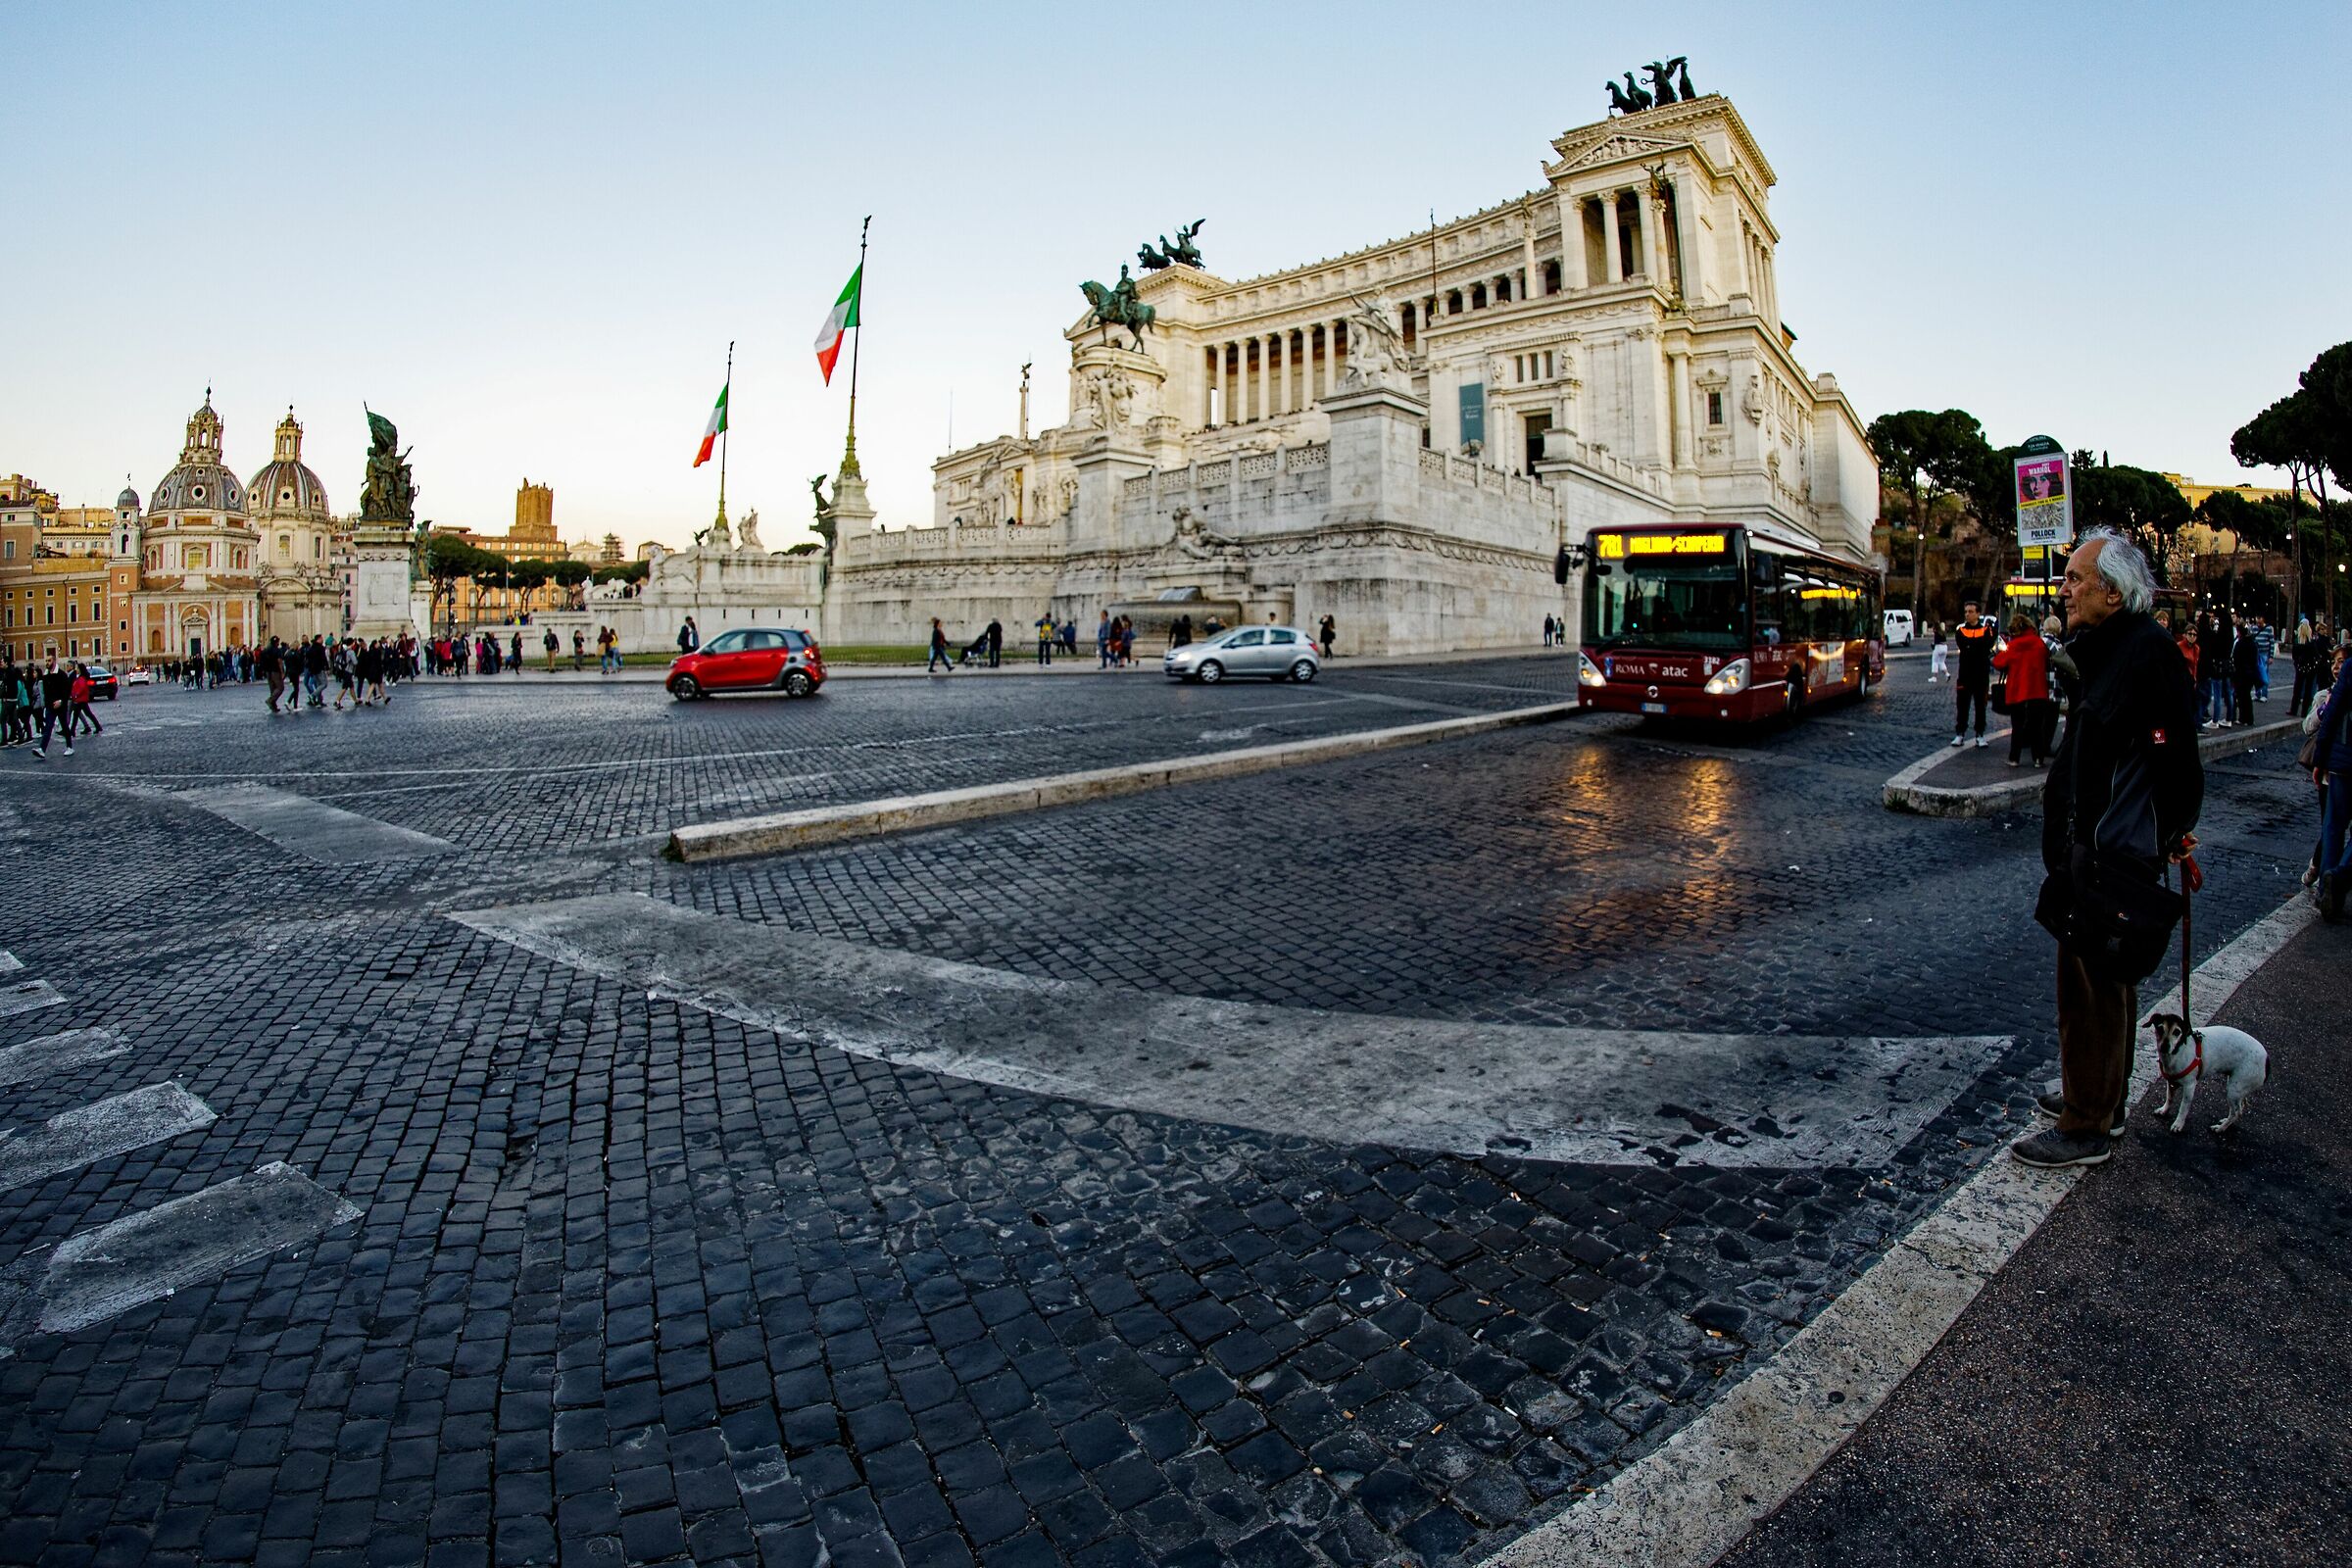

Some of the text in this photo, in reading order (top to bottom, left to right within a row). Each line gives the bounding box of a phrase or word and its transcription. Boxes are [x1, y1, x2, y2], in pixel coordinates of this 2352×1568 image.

[2031, 529, 2056, 538] POLLOCK
[1597, 534, 1624, 558] 781
[1615, 664, 1689, 678] ROMA atac
